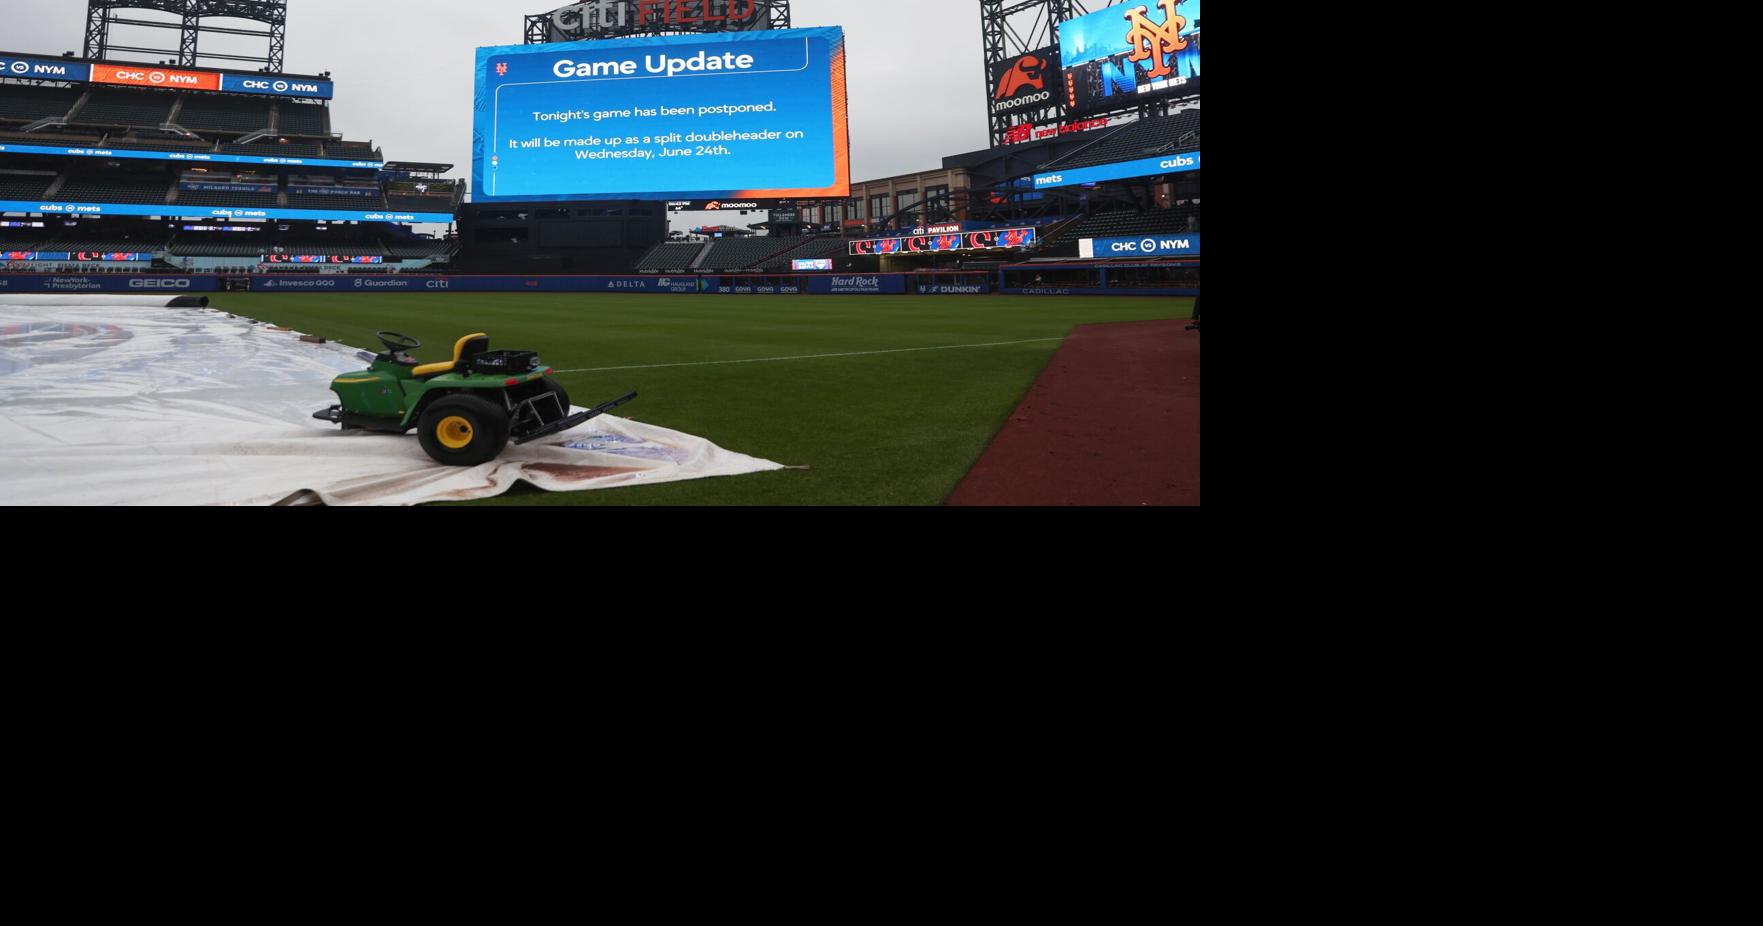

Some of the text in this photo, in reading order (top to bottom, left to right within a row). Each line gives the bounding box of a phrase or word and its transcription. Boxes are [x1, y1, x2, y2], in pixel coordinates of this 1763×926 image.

[639, 0, 755, 26] FIELD
[34, 64, 66, 75] NYM
[553, 51, 754, 78] Game Update
[116, 71, 144, 80] CHC
[169, 75, 198, 85] NYM
[243, 80, 269, 89] CHC
[291, 84, 318, 93] NYM
[996, 91, 1050, 111] moomoo
[533, 101, 777, 123] Tonight's game has been postponed.
[1035, 118, 1108, 138] new balance
[509, 129, 804, 149] It will be made up as a split doubleheader on
[575, 144, 731, 160] Wednesday, June 24th.
[1160, 156, 1194, 169] cubs
[1036, 174, 1062, 185] mets
[928, 225, 959, 234] PAVILION
[1112, 242, 1137, 252] CHC
[1160, 239, 1190, 250] NYM
[129, 278, 190, 288] GEICO
[832, 276, 880, 287] Hard Rock
